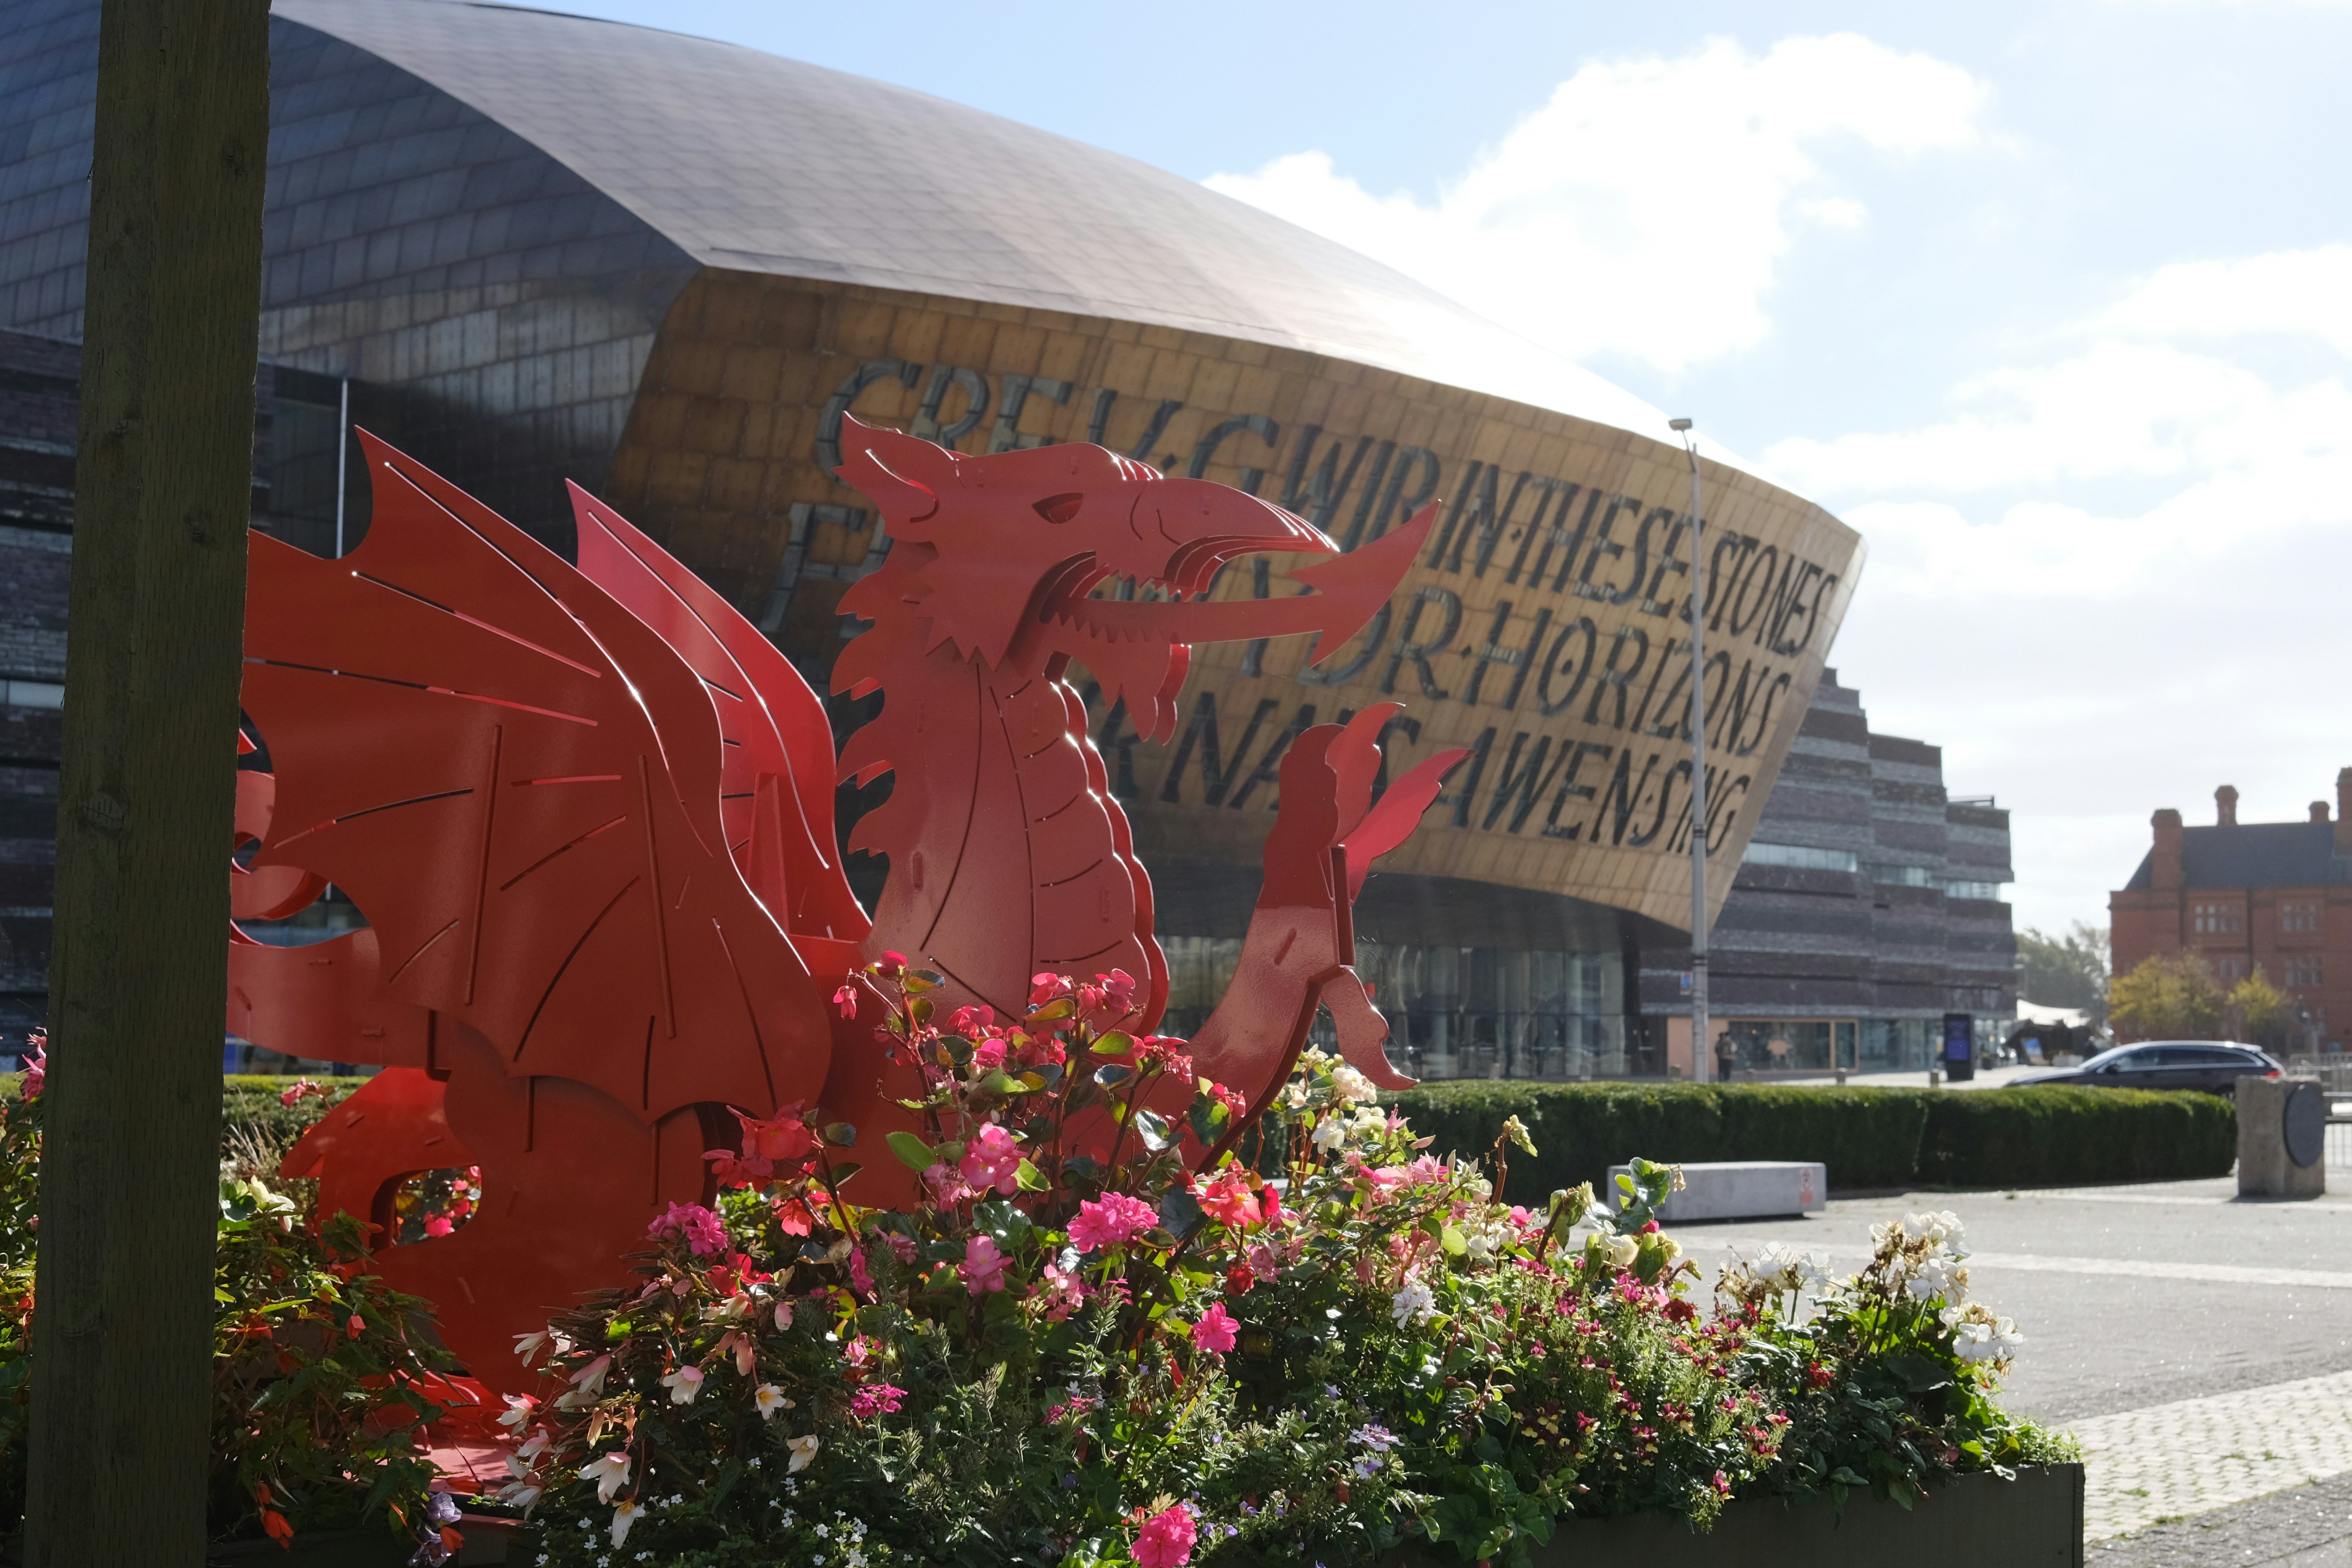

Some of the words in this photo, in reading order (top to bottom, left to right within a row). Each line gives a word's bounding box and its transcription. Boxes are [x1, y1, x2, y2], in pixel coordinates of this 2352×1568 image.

[1189, 414, 1441, 554] GWIR
[1427, 461, 1531, 579] IN
[1504, 472, 1706, 618] THESE
[1678, 530, 1838, 656] STONES
[1462, 601, 1791, 757] HORIZONS
[1437, 727, 1659, 845] AWEN
[1628, 759, 1751, 858] SING
